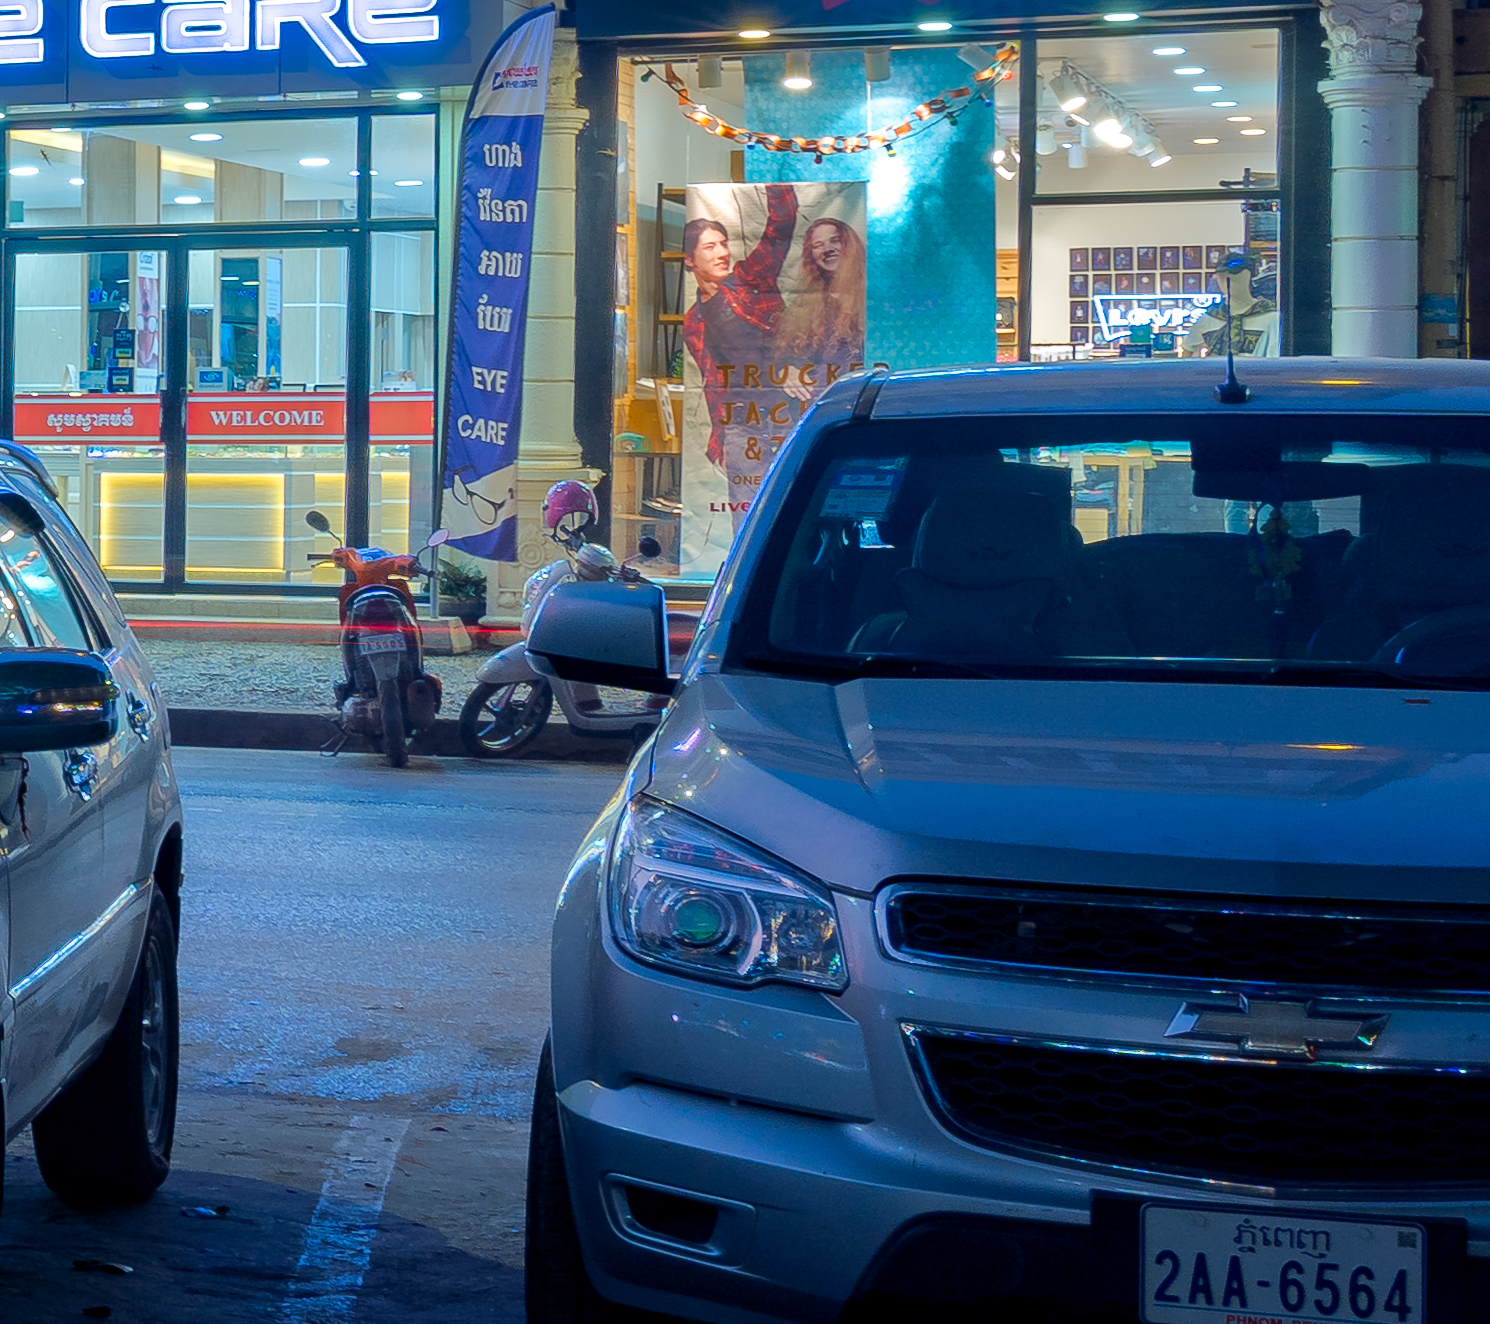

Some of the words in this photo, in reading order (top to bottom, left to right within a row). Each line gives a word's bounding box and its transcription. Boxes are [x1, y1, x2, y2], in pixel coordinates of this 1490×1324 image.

[471, 366, 509, 394] EYE
[209, 410, 324, 426] WELCOME
[457, 414, 509, 446] CARE
[732, 475, 761, 486] ONE
[1154, 1249, 1412, 1323] 2AA-6564
